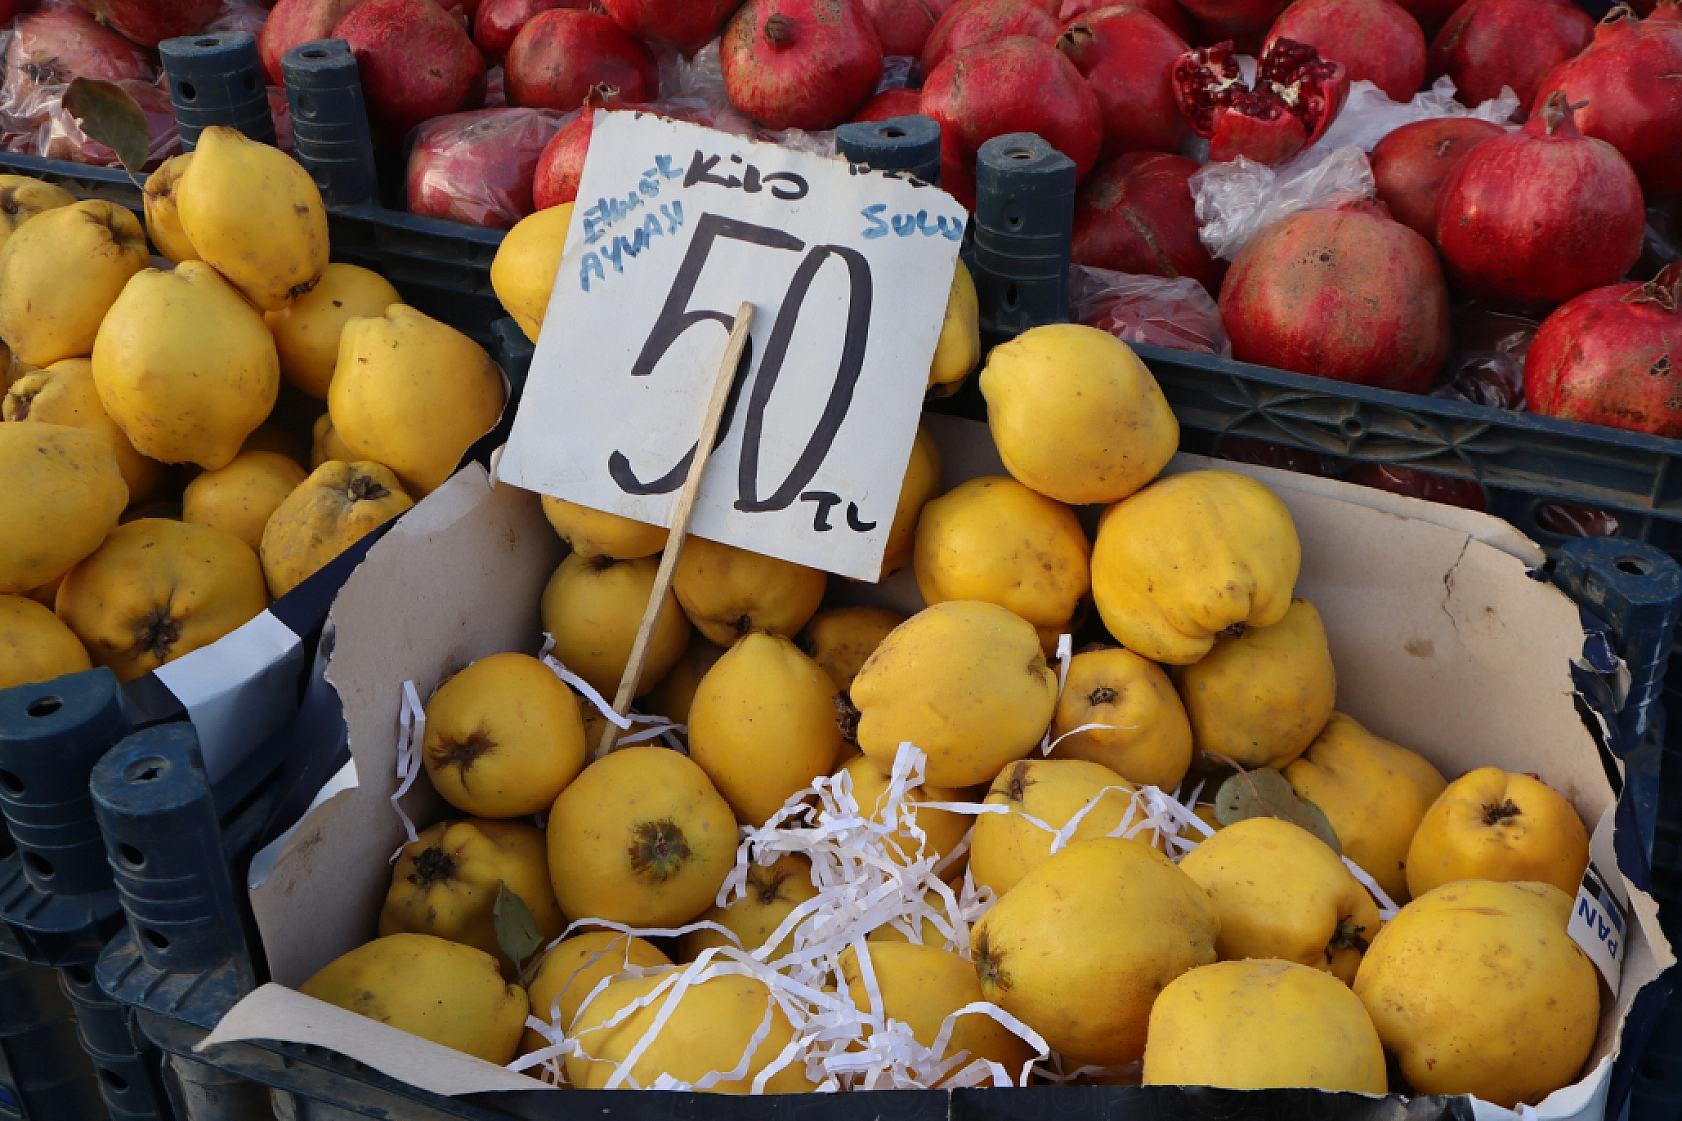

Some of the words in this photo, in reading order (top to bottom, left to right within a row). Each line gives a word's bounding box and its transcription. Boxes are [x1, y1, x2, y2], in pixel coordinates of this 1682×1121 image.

[860, 203, 964, 241] SULU
[607, 211, 874, 513] 50
[800, 491, 877, 532] TL
[1577, 893, 1619, 960] PAN
